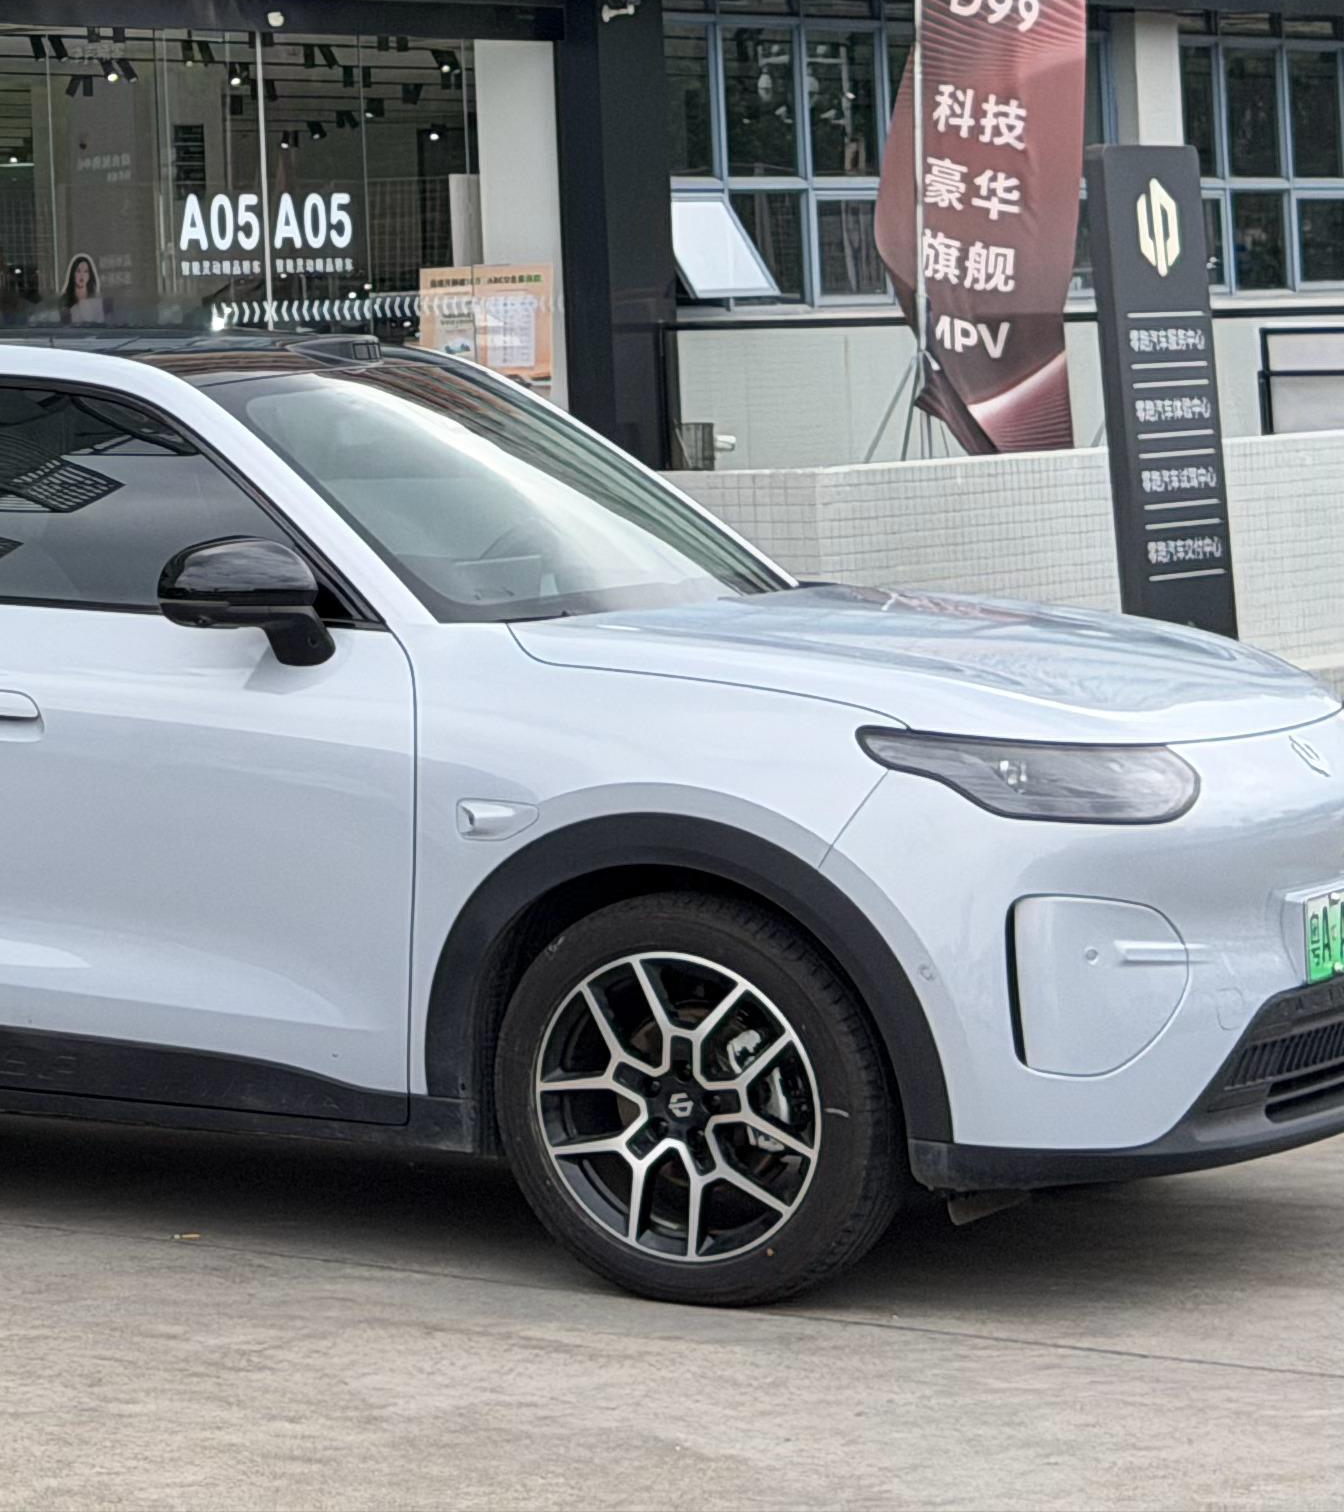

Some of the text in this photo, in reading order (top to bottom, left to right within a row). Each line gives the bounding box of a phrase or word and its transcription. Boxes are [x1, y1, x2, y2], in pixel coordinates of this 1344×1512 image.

[932, 83, 1028, 151] 科技
[923, 156, 1022, 221] 豪华
[180, 193, 260, 251] A05
[274, 192, 353, 250] A05
[922, 228, 1016, 293] 旗舰
[1147, 536, 1222, 564] 零跑汽车交付中心
